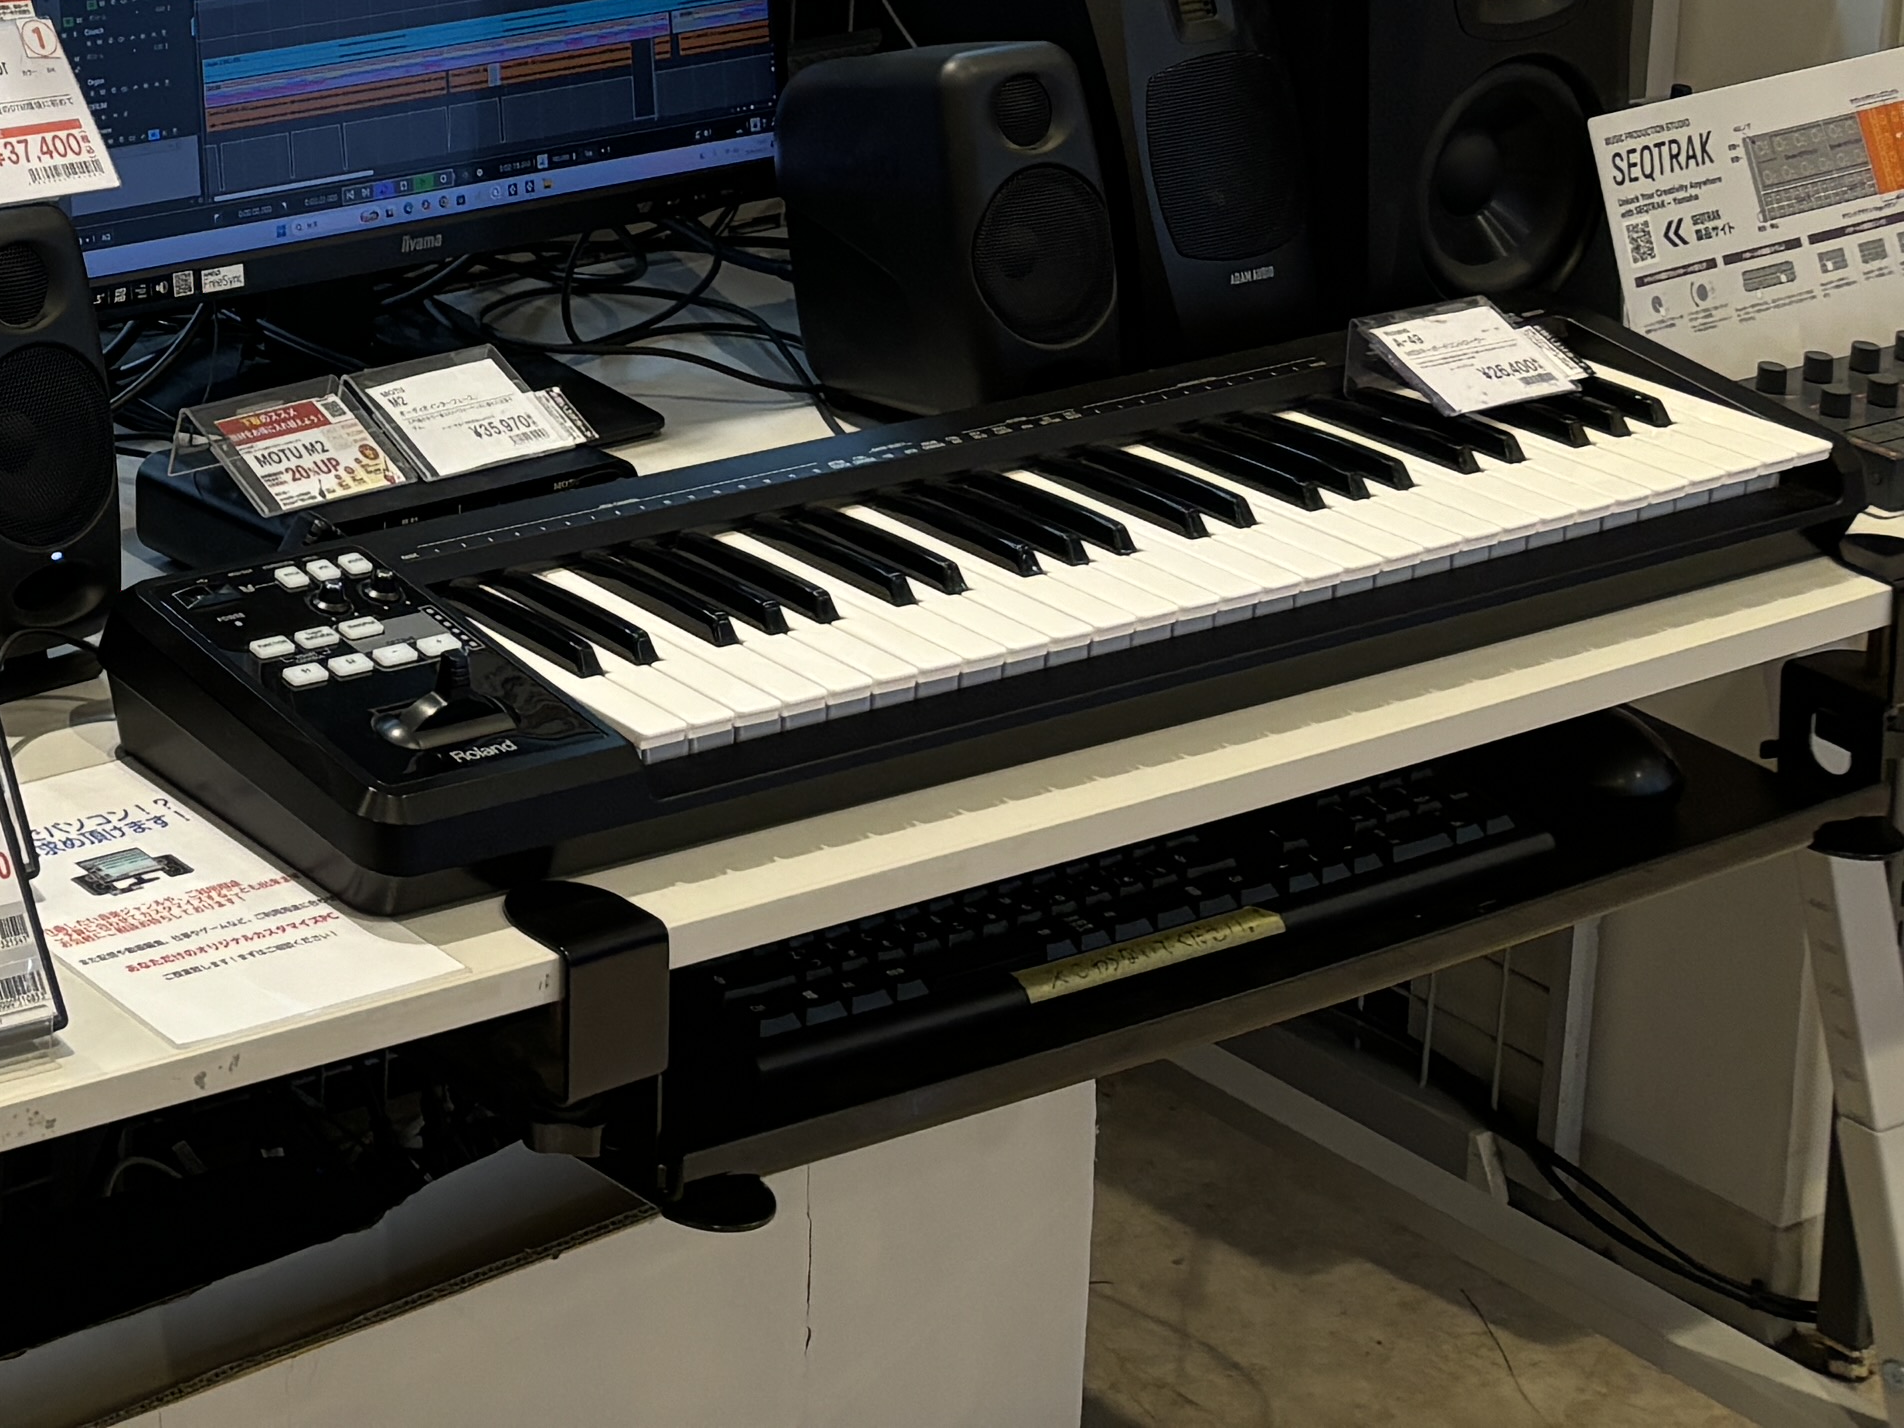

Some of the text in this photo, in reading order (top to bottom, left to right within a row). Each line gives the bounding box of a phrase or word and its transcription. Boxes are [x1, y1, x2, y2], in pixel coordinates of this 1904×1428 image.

[1611, 130, 1715, 187] SEQTRAK
[401, 233, 443, 253] iiyama
[253, 440, 330, 469] MOTU M2
[449, 740, 519, 763] Roland
